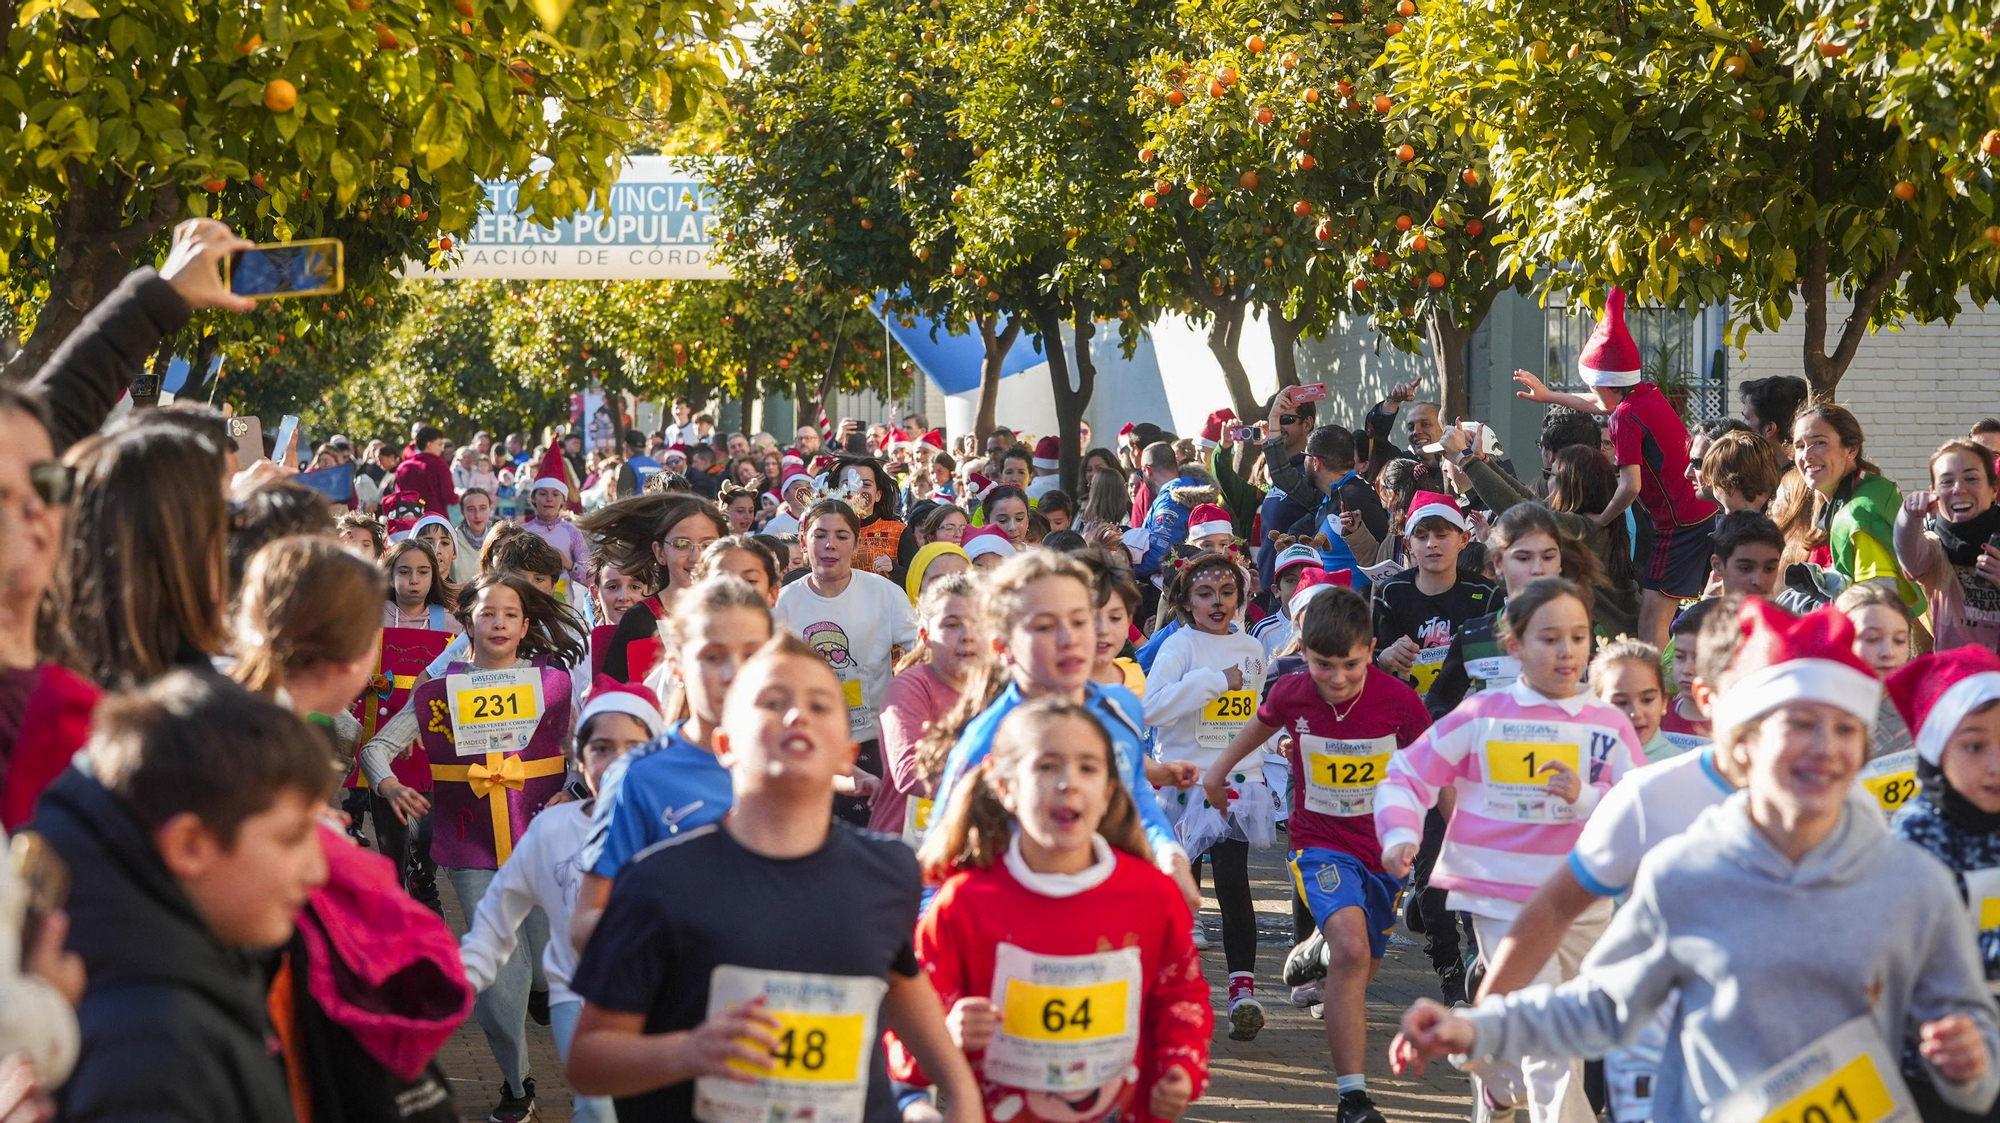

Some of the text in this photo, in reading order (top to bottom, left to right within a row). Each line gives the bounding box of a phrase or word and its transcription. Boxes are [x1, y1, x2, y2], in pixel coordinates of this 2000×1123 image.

[467, 214, 722, 243] ERAS POPULAR
[578, 250, 609, 265] DE
[629, 246, 706, 265] CÓRD
[473, 692, 518, 718] 231
[1217, 696, 1252, 717] 258
[478, 721, 508, 729] SILVESTRE
[463, 738, 488, 746] IMDECO
[1326, 762, 1375, 783] 122
[1522, 751, 1535, 778] 1
[1884, 779, 1916, 804] 82
[1041, 997, 1093, 1033] 64
[771, 1027, 829, 1070] 48
[1782, 1086, 1860, 1123] 01
